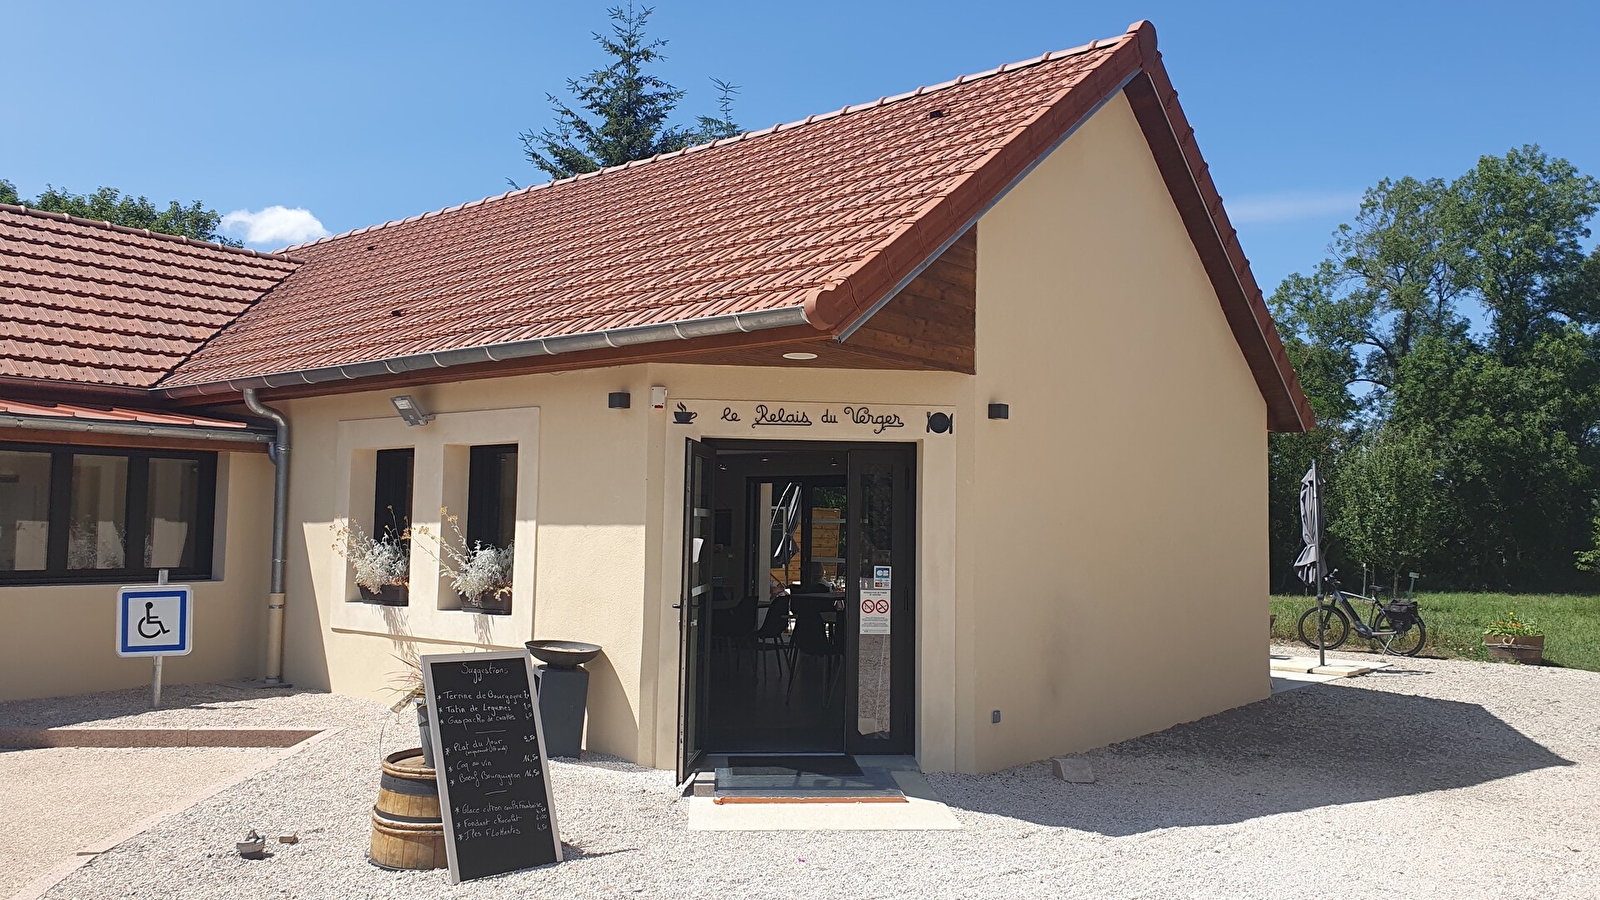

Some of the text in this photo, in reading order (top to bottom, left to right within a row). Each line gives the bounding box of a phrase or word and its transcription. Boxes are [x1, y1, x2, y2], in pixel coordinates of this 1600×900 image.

[721, 404, 905, 434] le Relais du Verger
[460, 662, 509, 684] Suggestions
[443, 690, 473, 700] Terrine
[476, 690, 486, 700] de
[487, 689, 522, 704] Bourgogne
[469, 704, 478, 712] de
[453, 741, 469, 752] Plat
[472, 739, 483, 748] du
[456, 760, 470, 772] Coq
